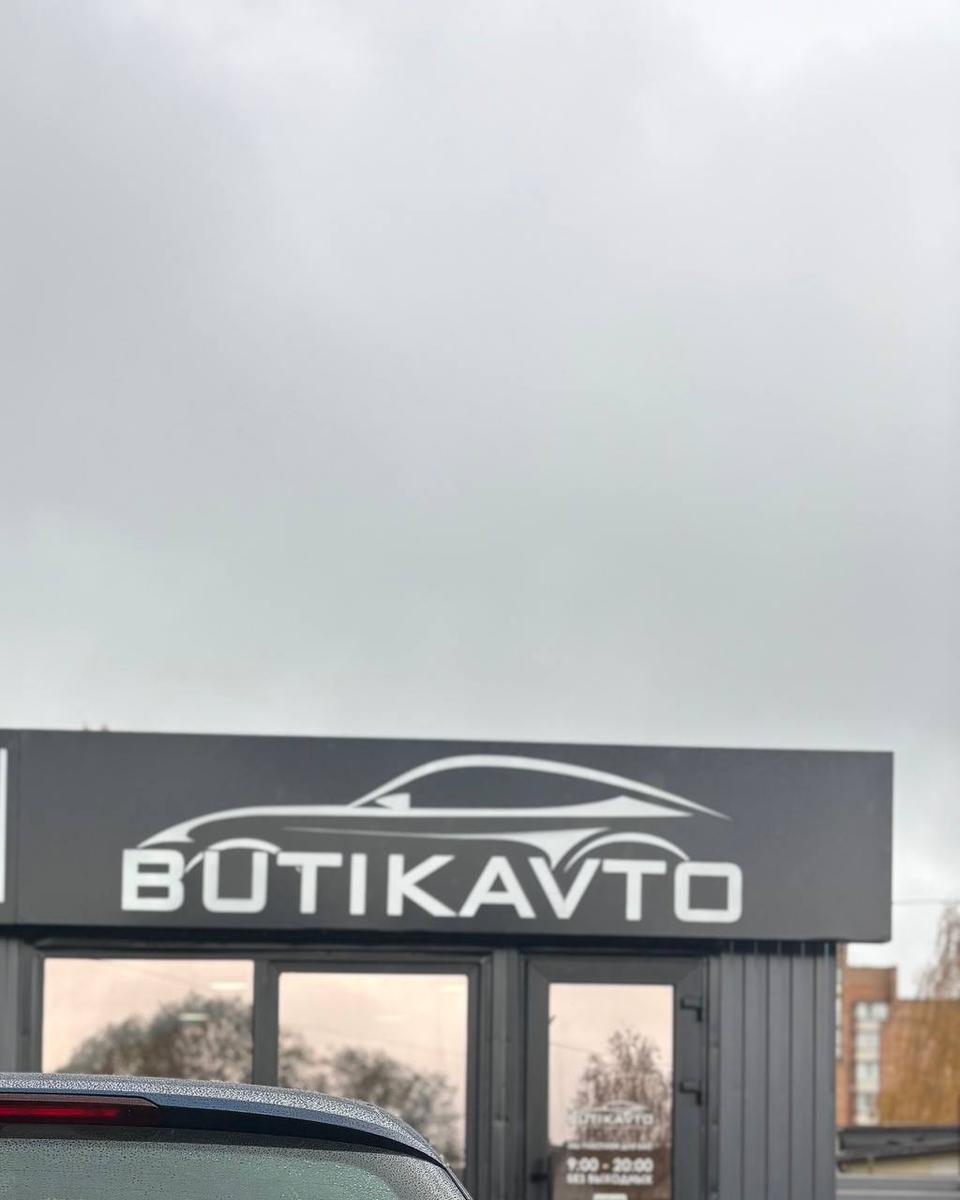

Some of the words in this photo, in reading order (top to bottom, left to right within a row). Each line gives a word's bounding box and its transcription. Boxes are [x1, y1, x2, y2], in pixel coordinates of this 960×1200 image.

[121, 847, 743, 925] BUTIKAVTO
[566, 1157, 600, 1173] 9:00
[612, 1157, 654, 1173] 20:00
